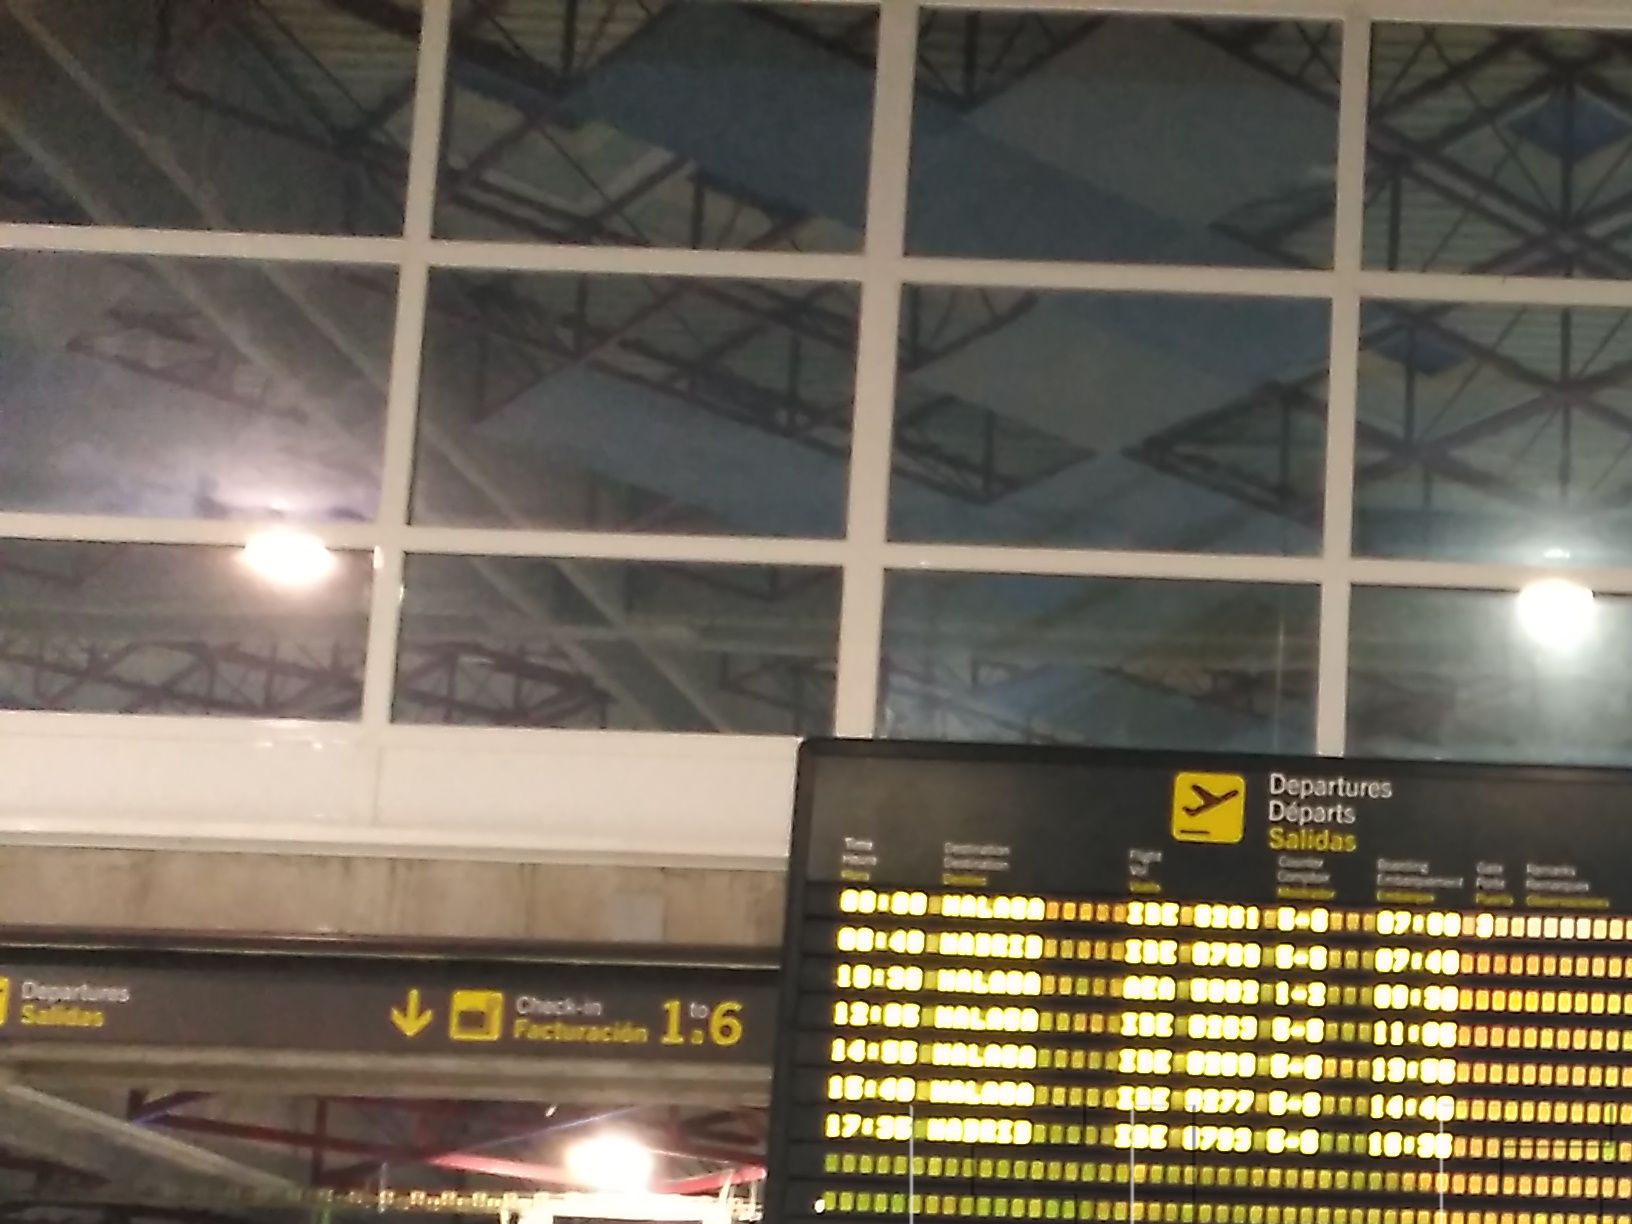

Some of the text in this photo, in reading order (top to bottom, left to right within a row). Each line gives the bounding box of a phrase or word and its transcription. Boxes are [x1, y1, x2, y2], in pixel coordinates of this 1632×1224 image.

[1269, 772, 1393, 800] Departures
[1268, 800, 1357, 826] Départs
[1268, 827, 1358, 852] Salidas
[660, 1000, 744, 1047] 1 6
